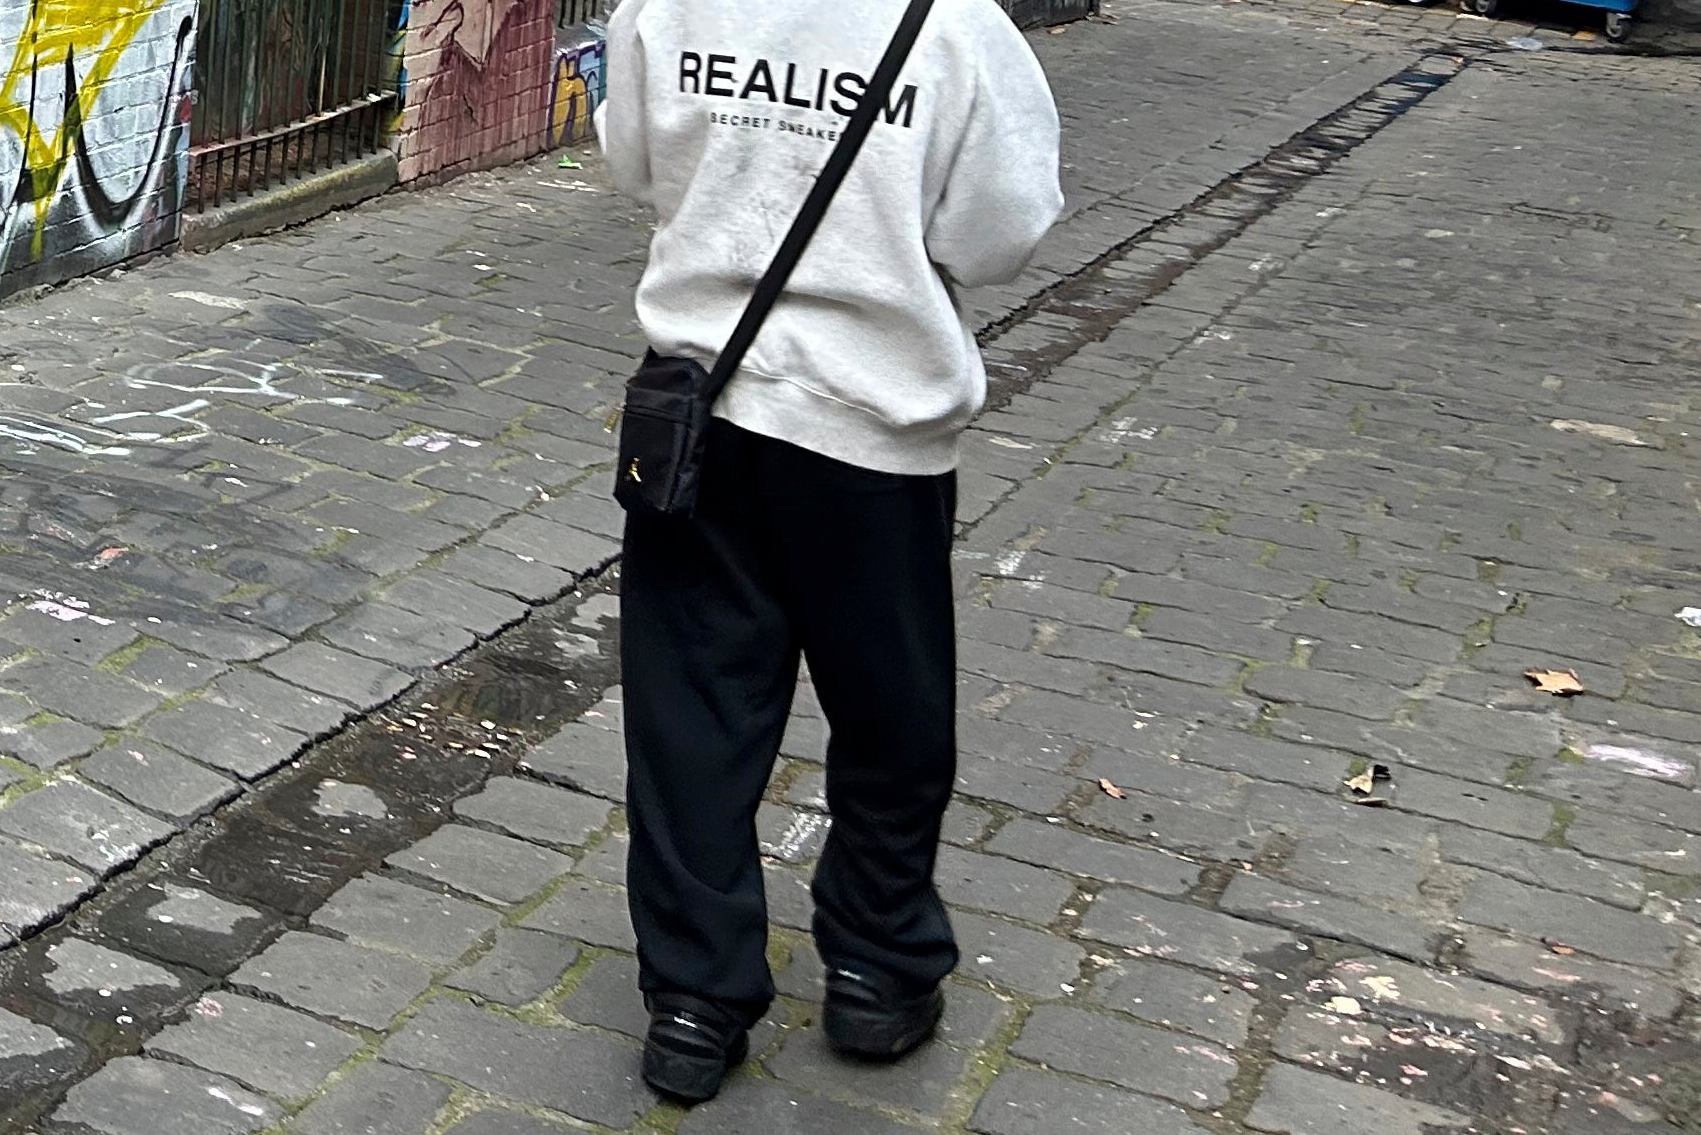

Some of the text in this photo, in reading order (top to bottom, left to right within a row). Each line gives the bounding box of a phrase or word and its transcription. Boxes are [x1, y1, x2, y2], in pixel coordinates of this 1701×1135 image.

[679, 51, 919, 128] REALISM
[710, 112, 842, 142] SECRET SNEAKE
